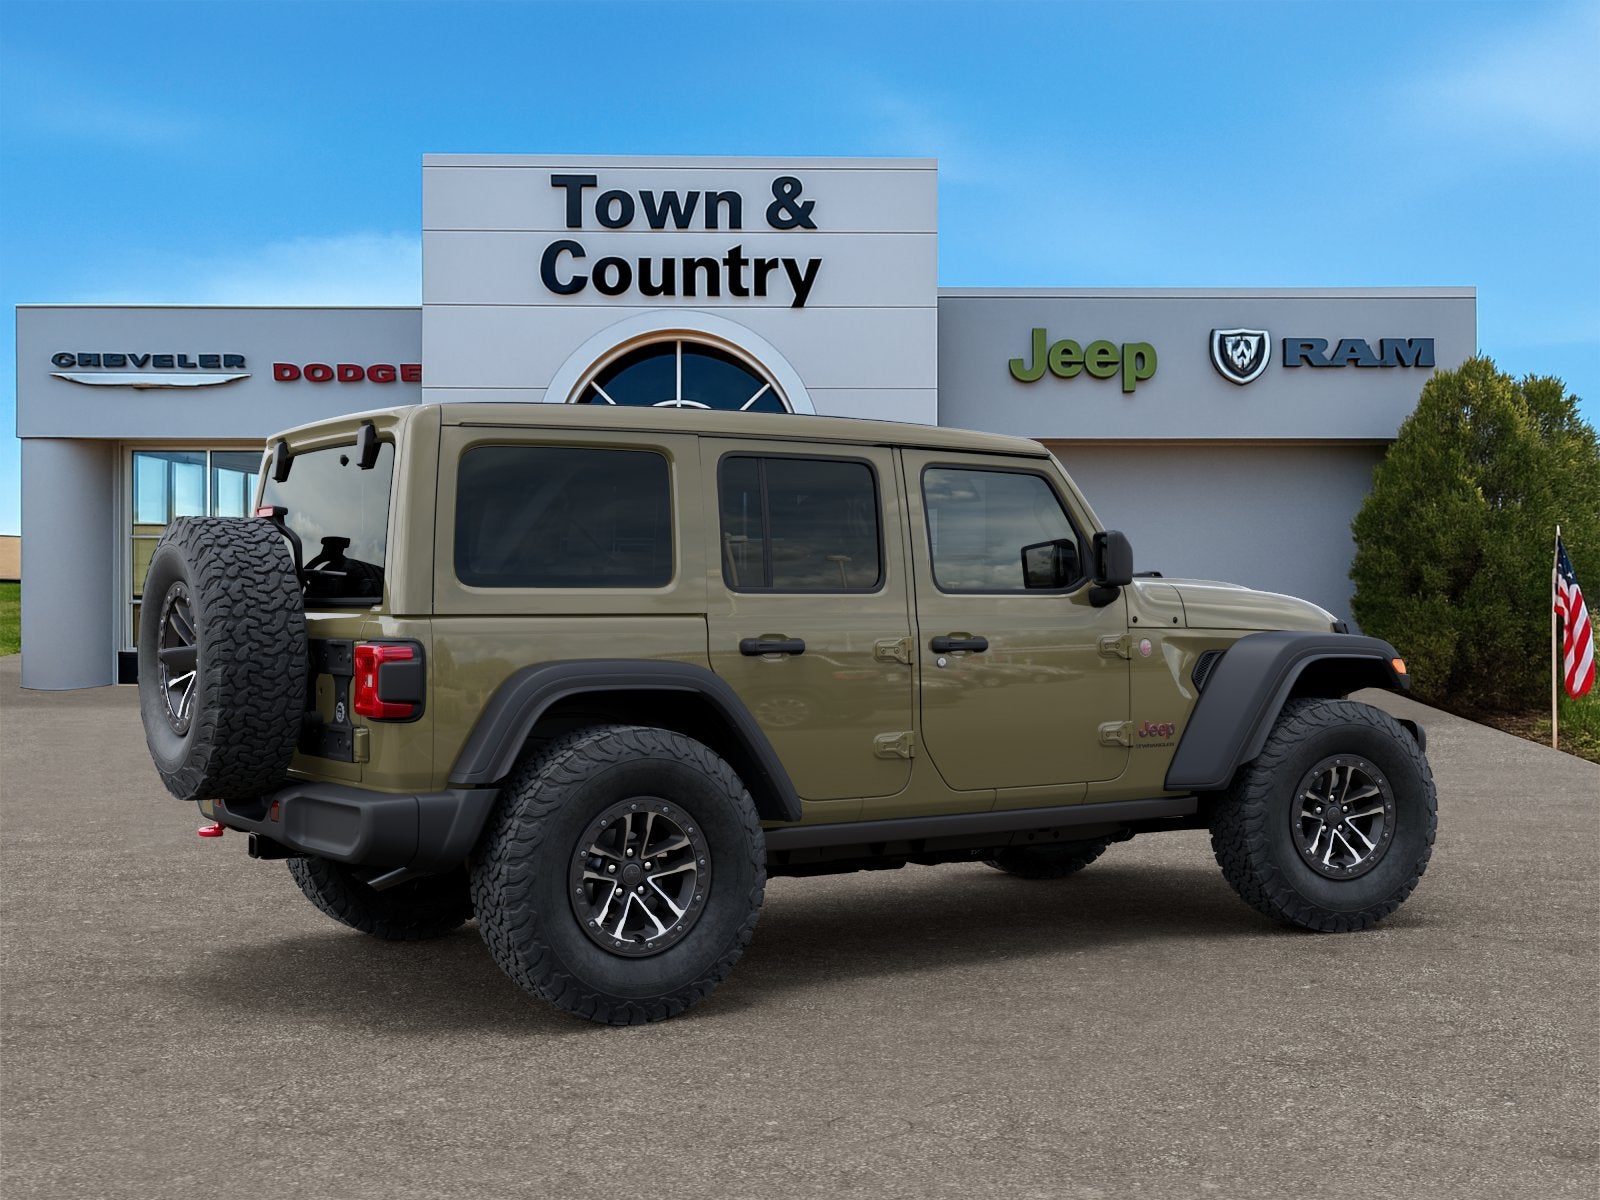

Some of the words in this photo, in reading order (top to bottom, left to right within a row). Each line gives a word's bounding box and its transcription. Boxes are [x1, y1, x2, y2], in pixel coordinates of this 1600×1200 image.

[550, 174, 743, 230] Town
[765, 175, 818, 230] &
[539, 239, 823, 308] Country
[273, 363, 422, 383] DODGE
[1009, 328, 1157, 392] Jeep
[1282, 337, 1436, 368] RAM
[1138, 720, 1175, 739] Jeep
